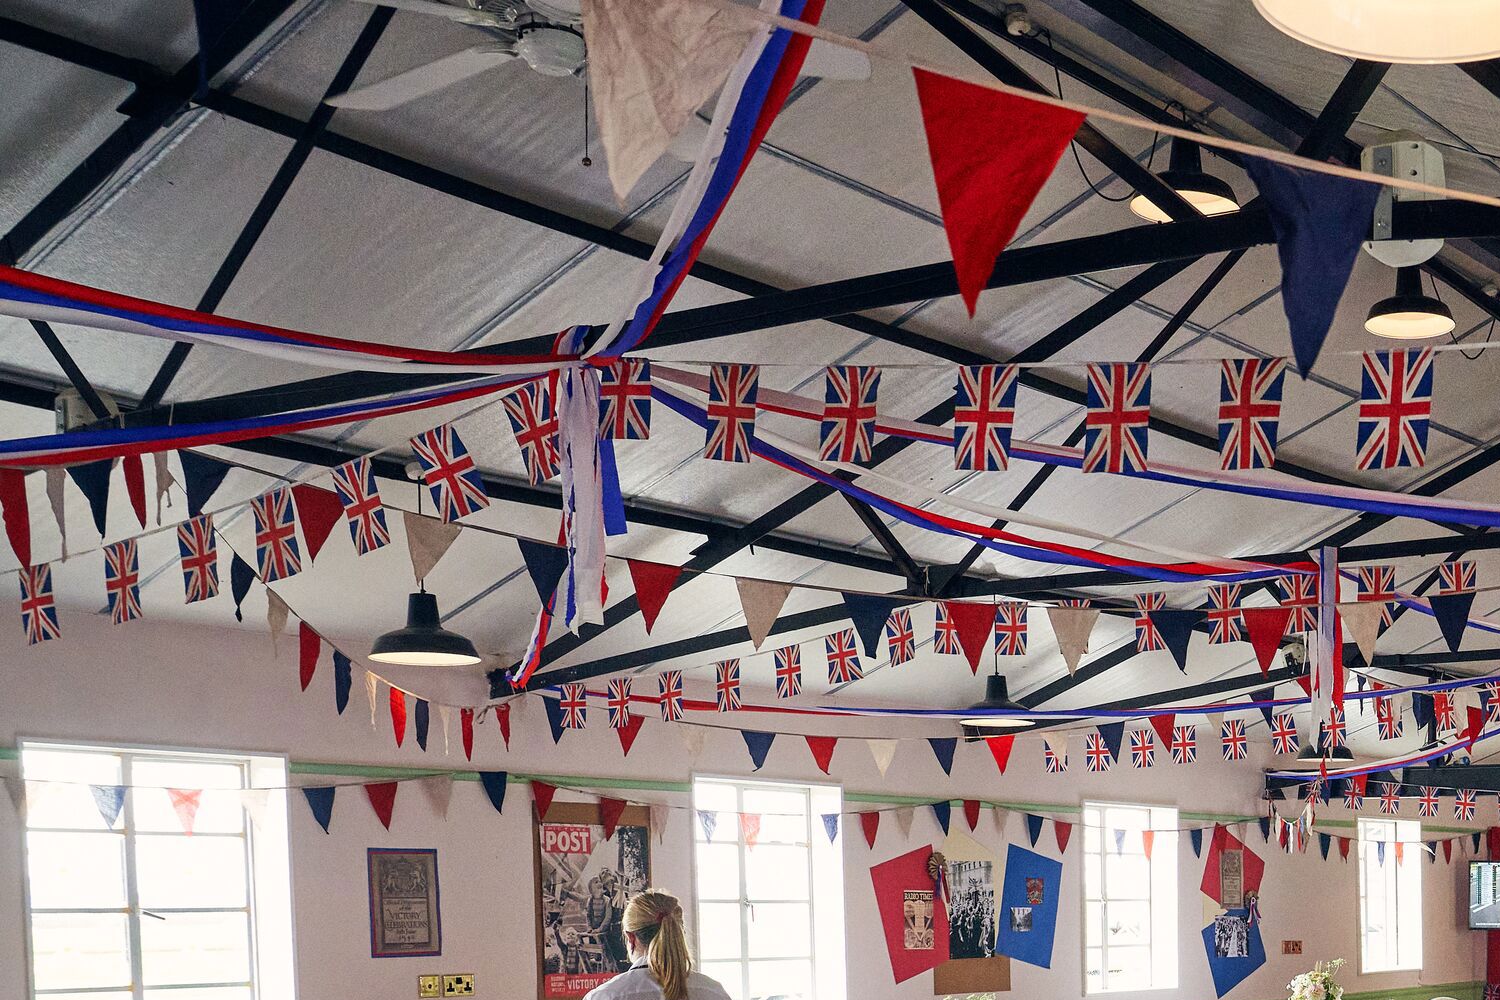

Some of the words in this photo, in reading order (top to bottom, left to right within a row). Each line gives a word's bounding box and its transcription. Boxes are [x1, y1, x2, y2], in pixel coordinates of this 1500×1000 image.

[545, 830, 589, 852] POST
[385, 909, 422, 920] VICTORY
[567, 979, 599, 990] VICTORY
